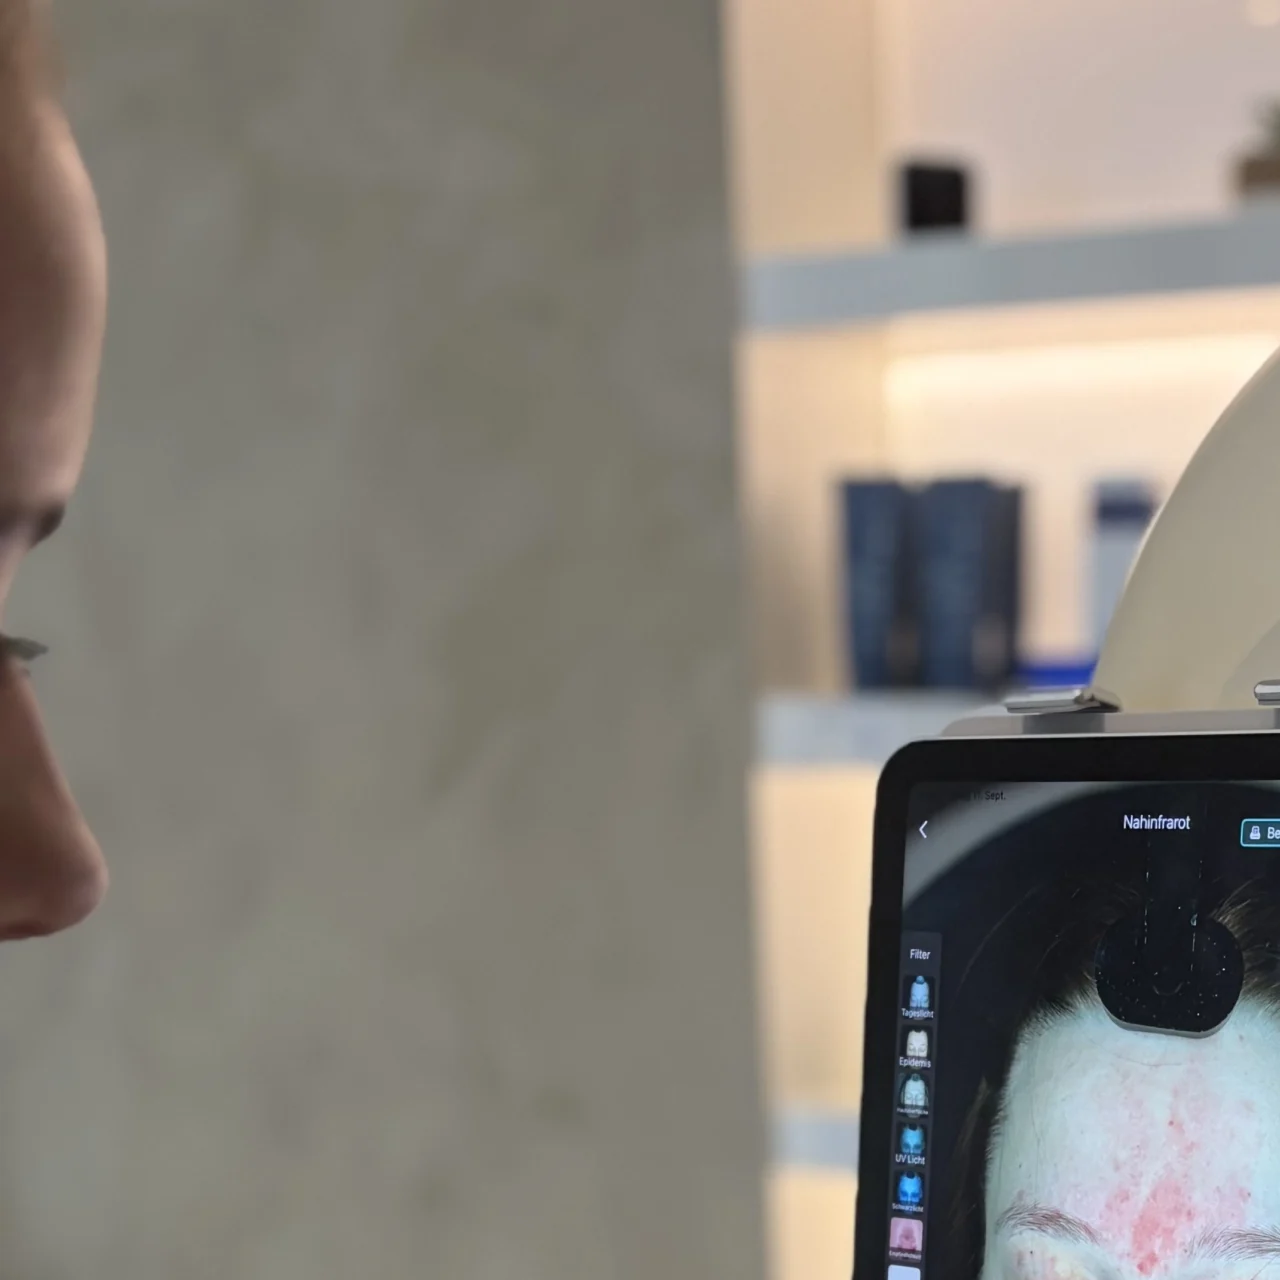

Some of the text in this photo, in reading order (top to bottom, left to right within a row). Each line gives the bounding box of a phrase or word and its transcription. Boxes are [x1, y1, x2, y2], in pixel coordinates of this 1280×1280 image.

[1123, 814, 1191, 830] Nahinfrarot
[909, 948, 931, 960] Filter
[901, 1007, 935, 1019] Tageslicht
[895, 1153, 926, 1166] UV Licht
